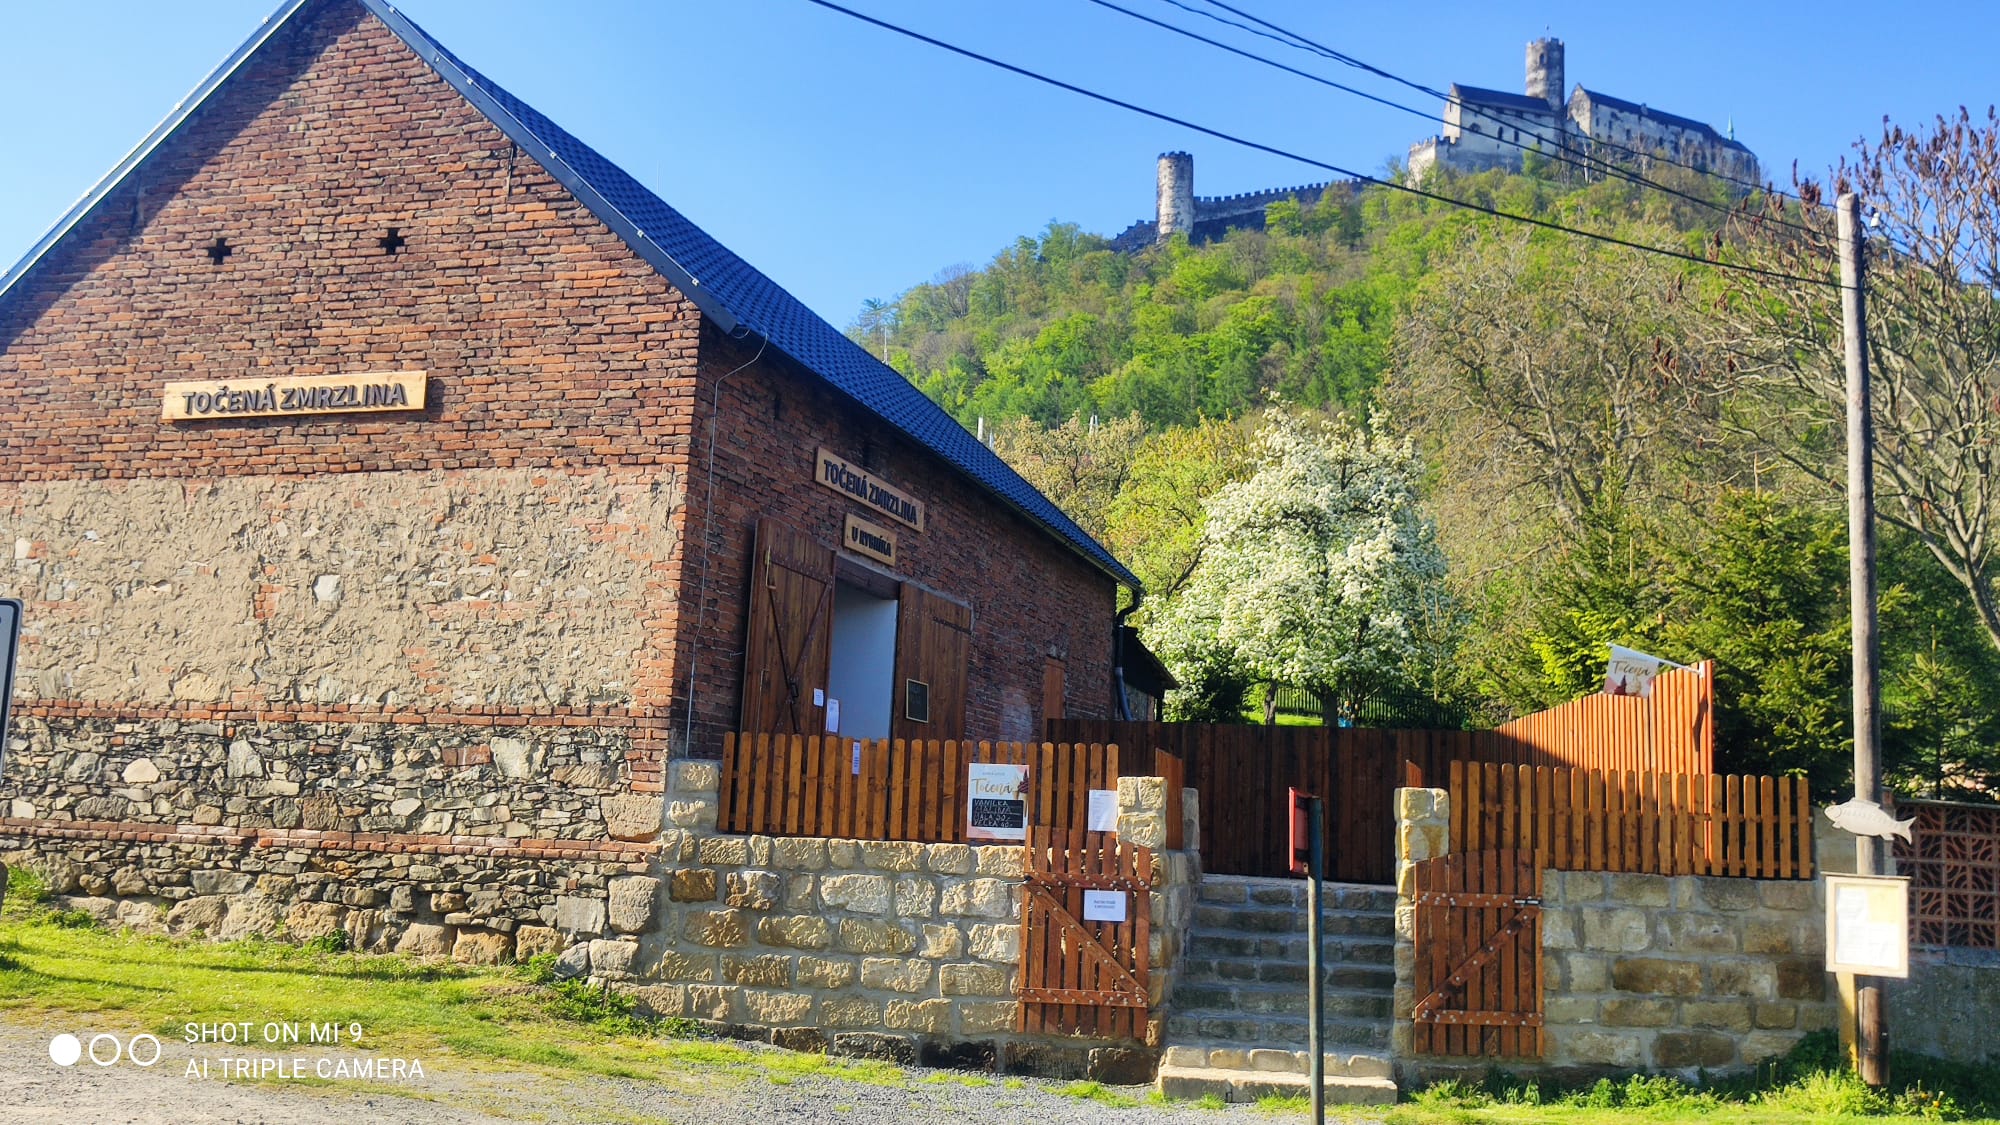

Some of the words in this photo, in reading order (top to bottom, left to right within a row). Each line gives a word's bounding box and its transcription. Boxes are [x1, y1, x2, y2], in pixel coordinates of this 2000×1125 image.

[182, 383, 277, 415] TOČENÁ
[280, 382, 408, 410] ZMRZLINA
[823, 459, 868, 500] TOČENÁ
[868, 482, 918, 525] ZMRZLINA
[851, 526, 859, 542] U
[974, 799, 1009, 807] VANILKA
